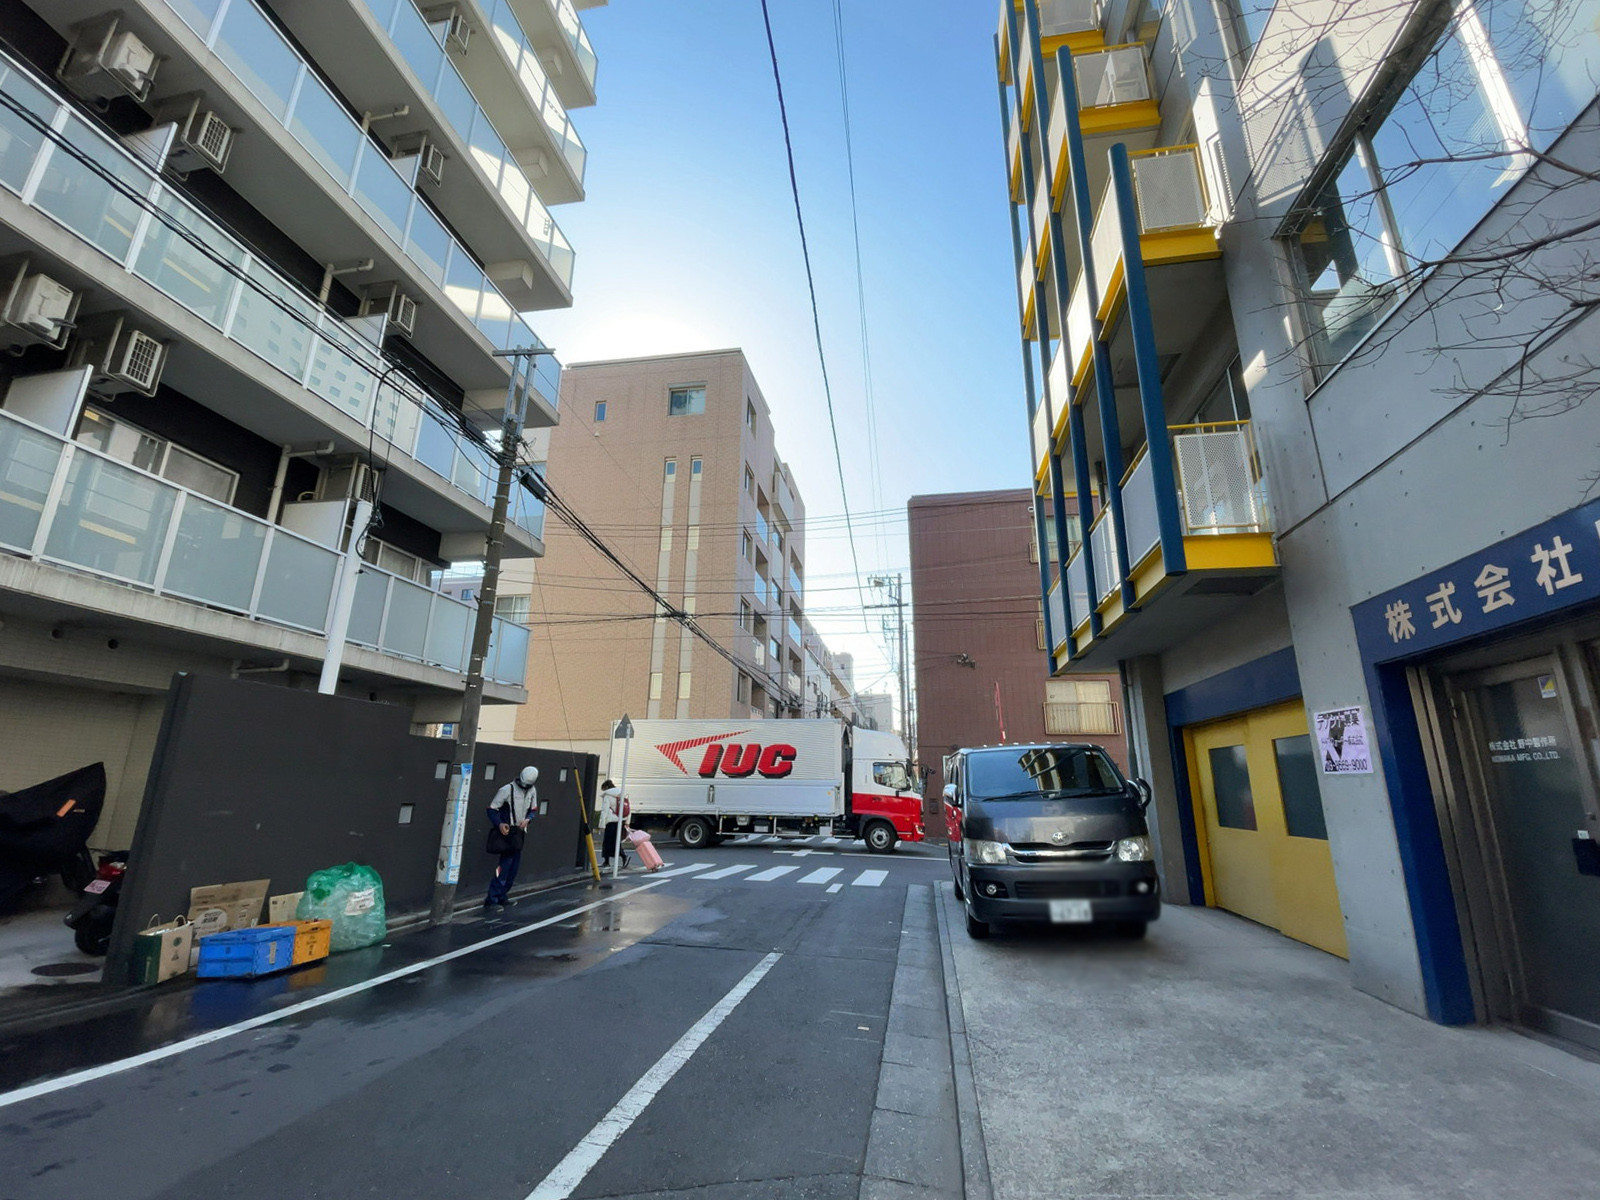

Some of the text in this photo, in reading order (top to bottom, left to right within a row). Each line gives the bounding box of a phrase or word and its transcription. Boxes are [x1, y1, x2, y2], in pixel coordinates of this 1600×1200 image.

[1384, 520, 1600, 645] 株式会社
[698, 743, 797, 779] IUC
